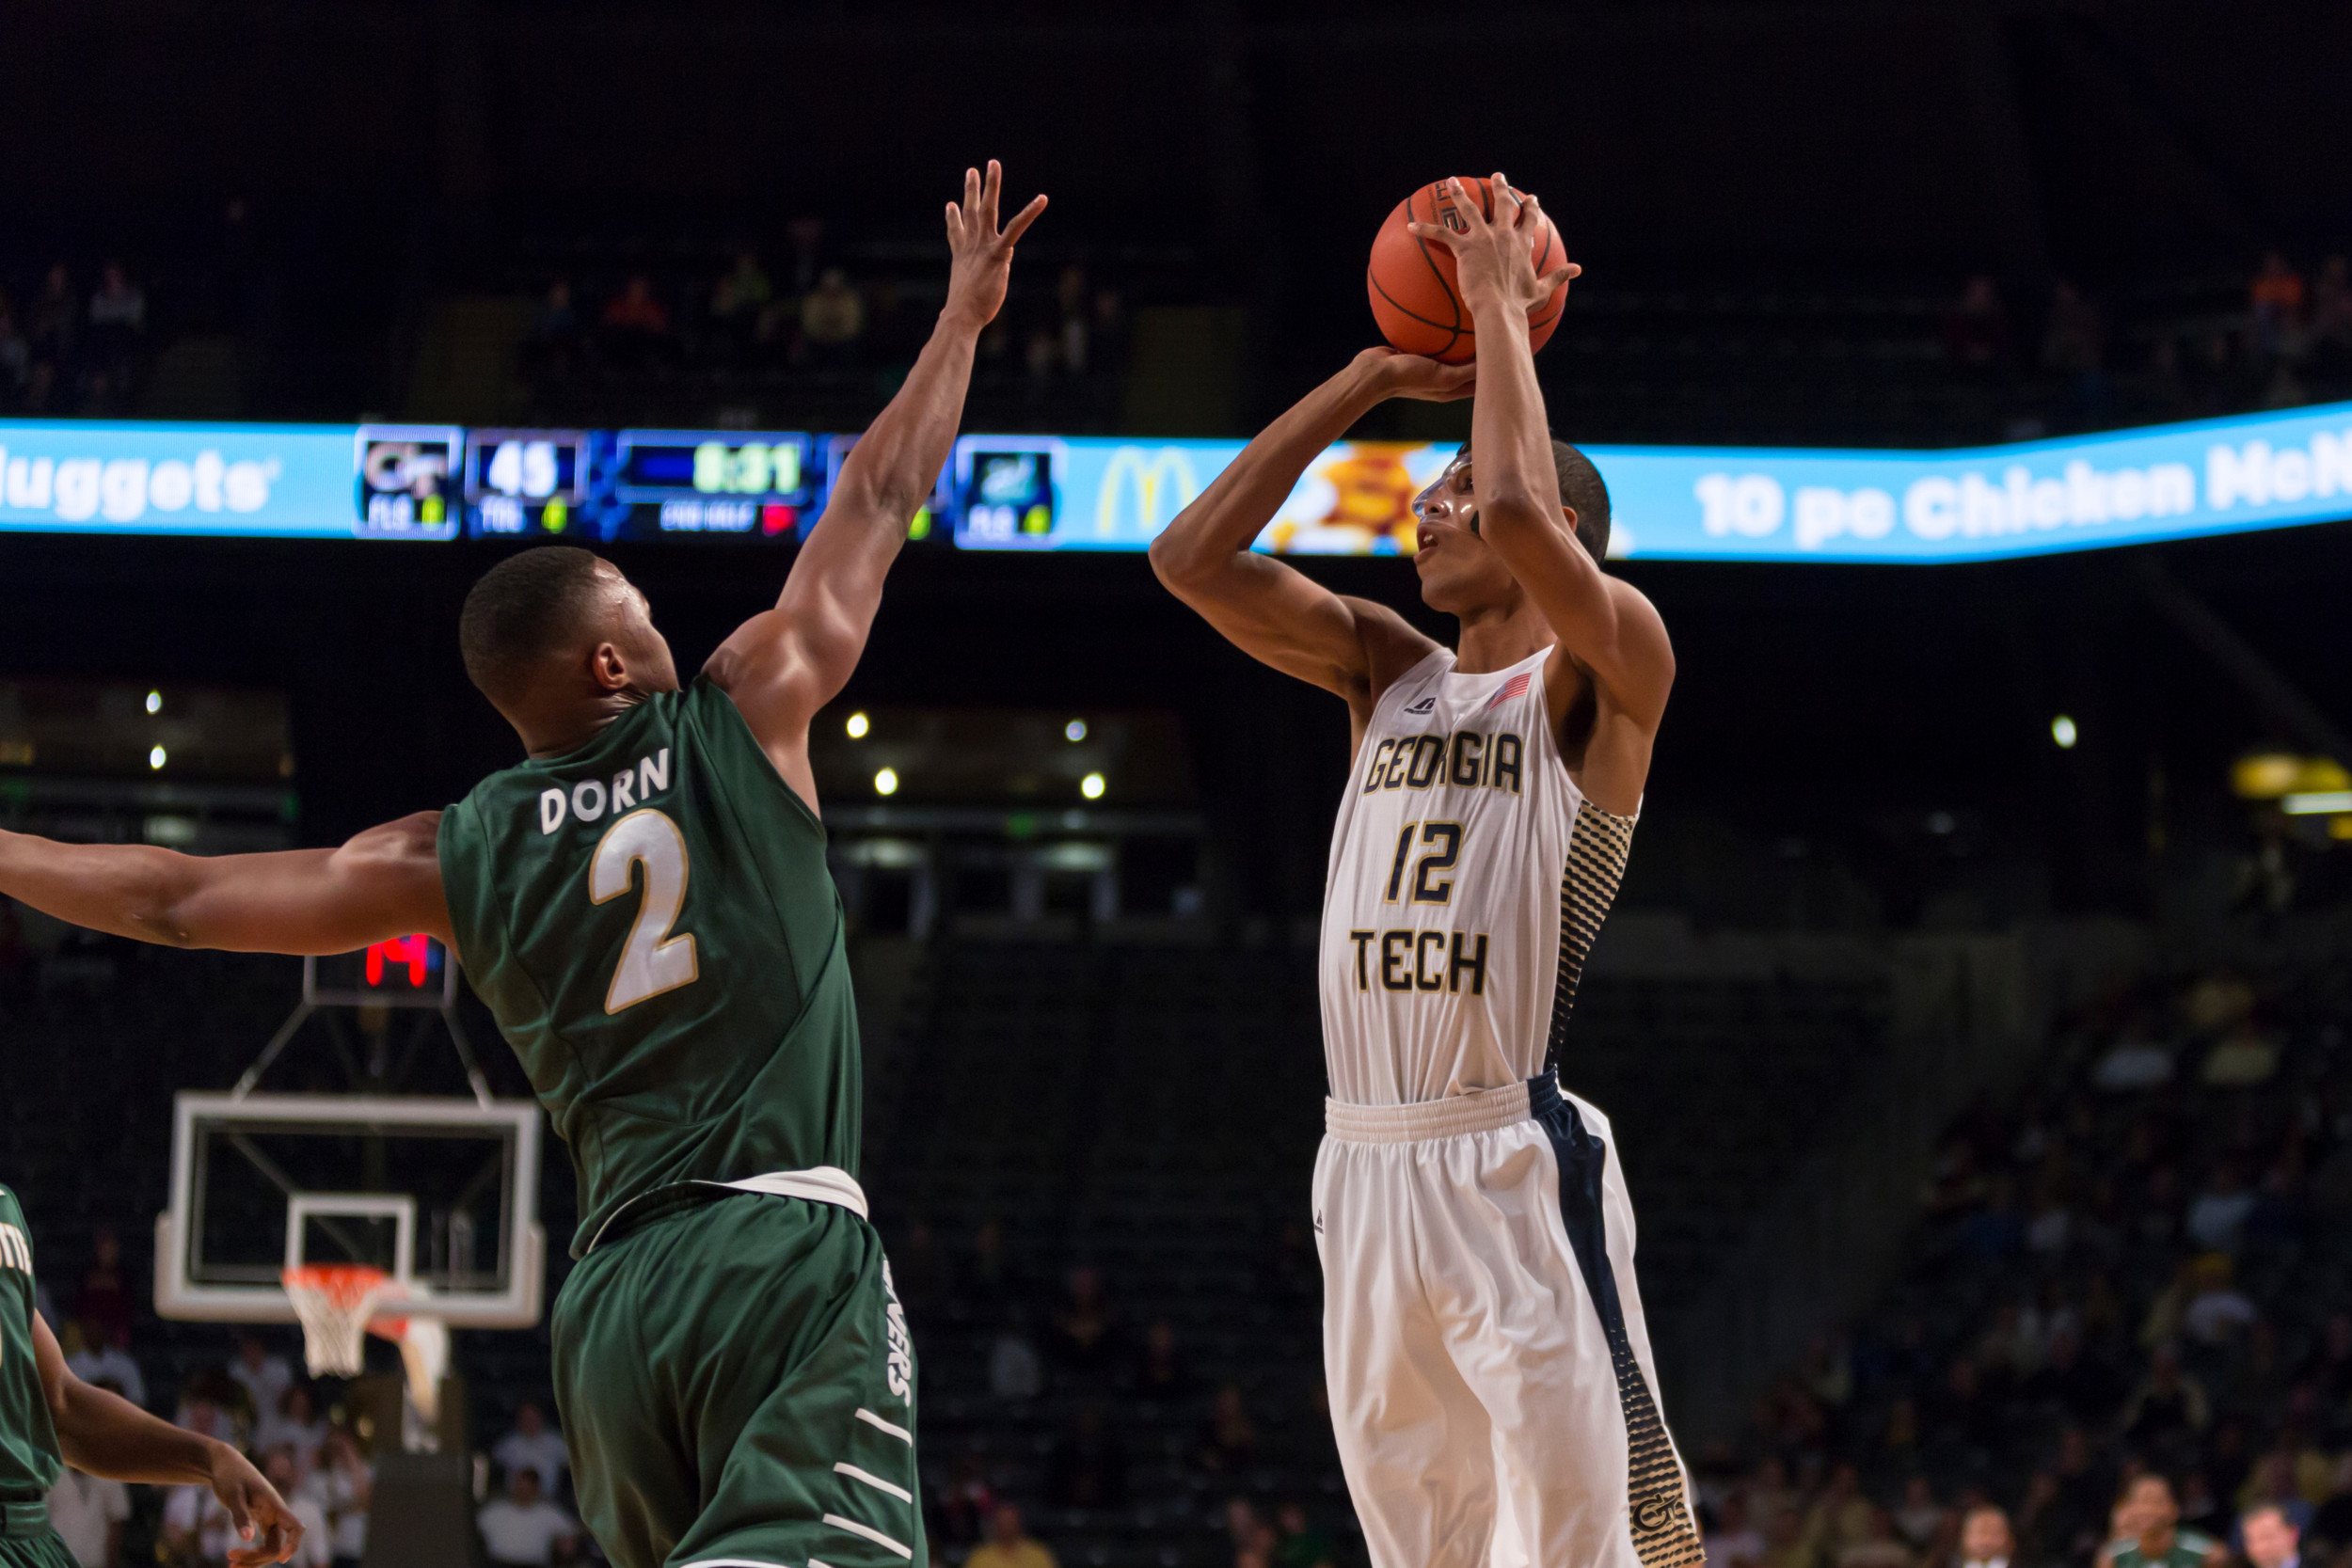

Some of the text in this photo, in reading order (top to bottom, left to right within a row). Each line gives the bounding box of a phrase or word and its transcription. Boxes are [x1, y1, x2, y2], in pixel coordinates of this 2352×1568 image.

[0, 444, 271, 522] uggets
[488, 440, 557, 498] 45
[1694, 471, 1785, 538] 10
[1902, 457, 2196, 541] Chicken
[540, 748, 670, 835] DORN
[1383, 820, 1465, 905] 12
[589, 808, 699, 1016] 2
[1349, 928, 1489, 997] TECH
